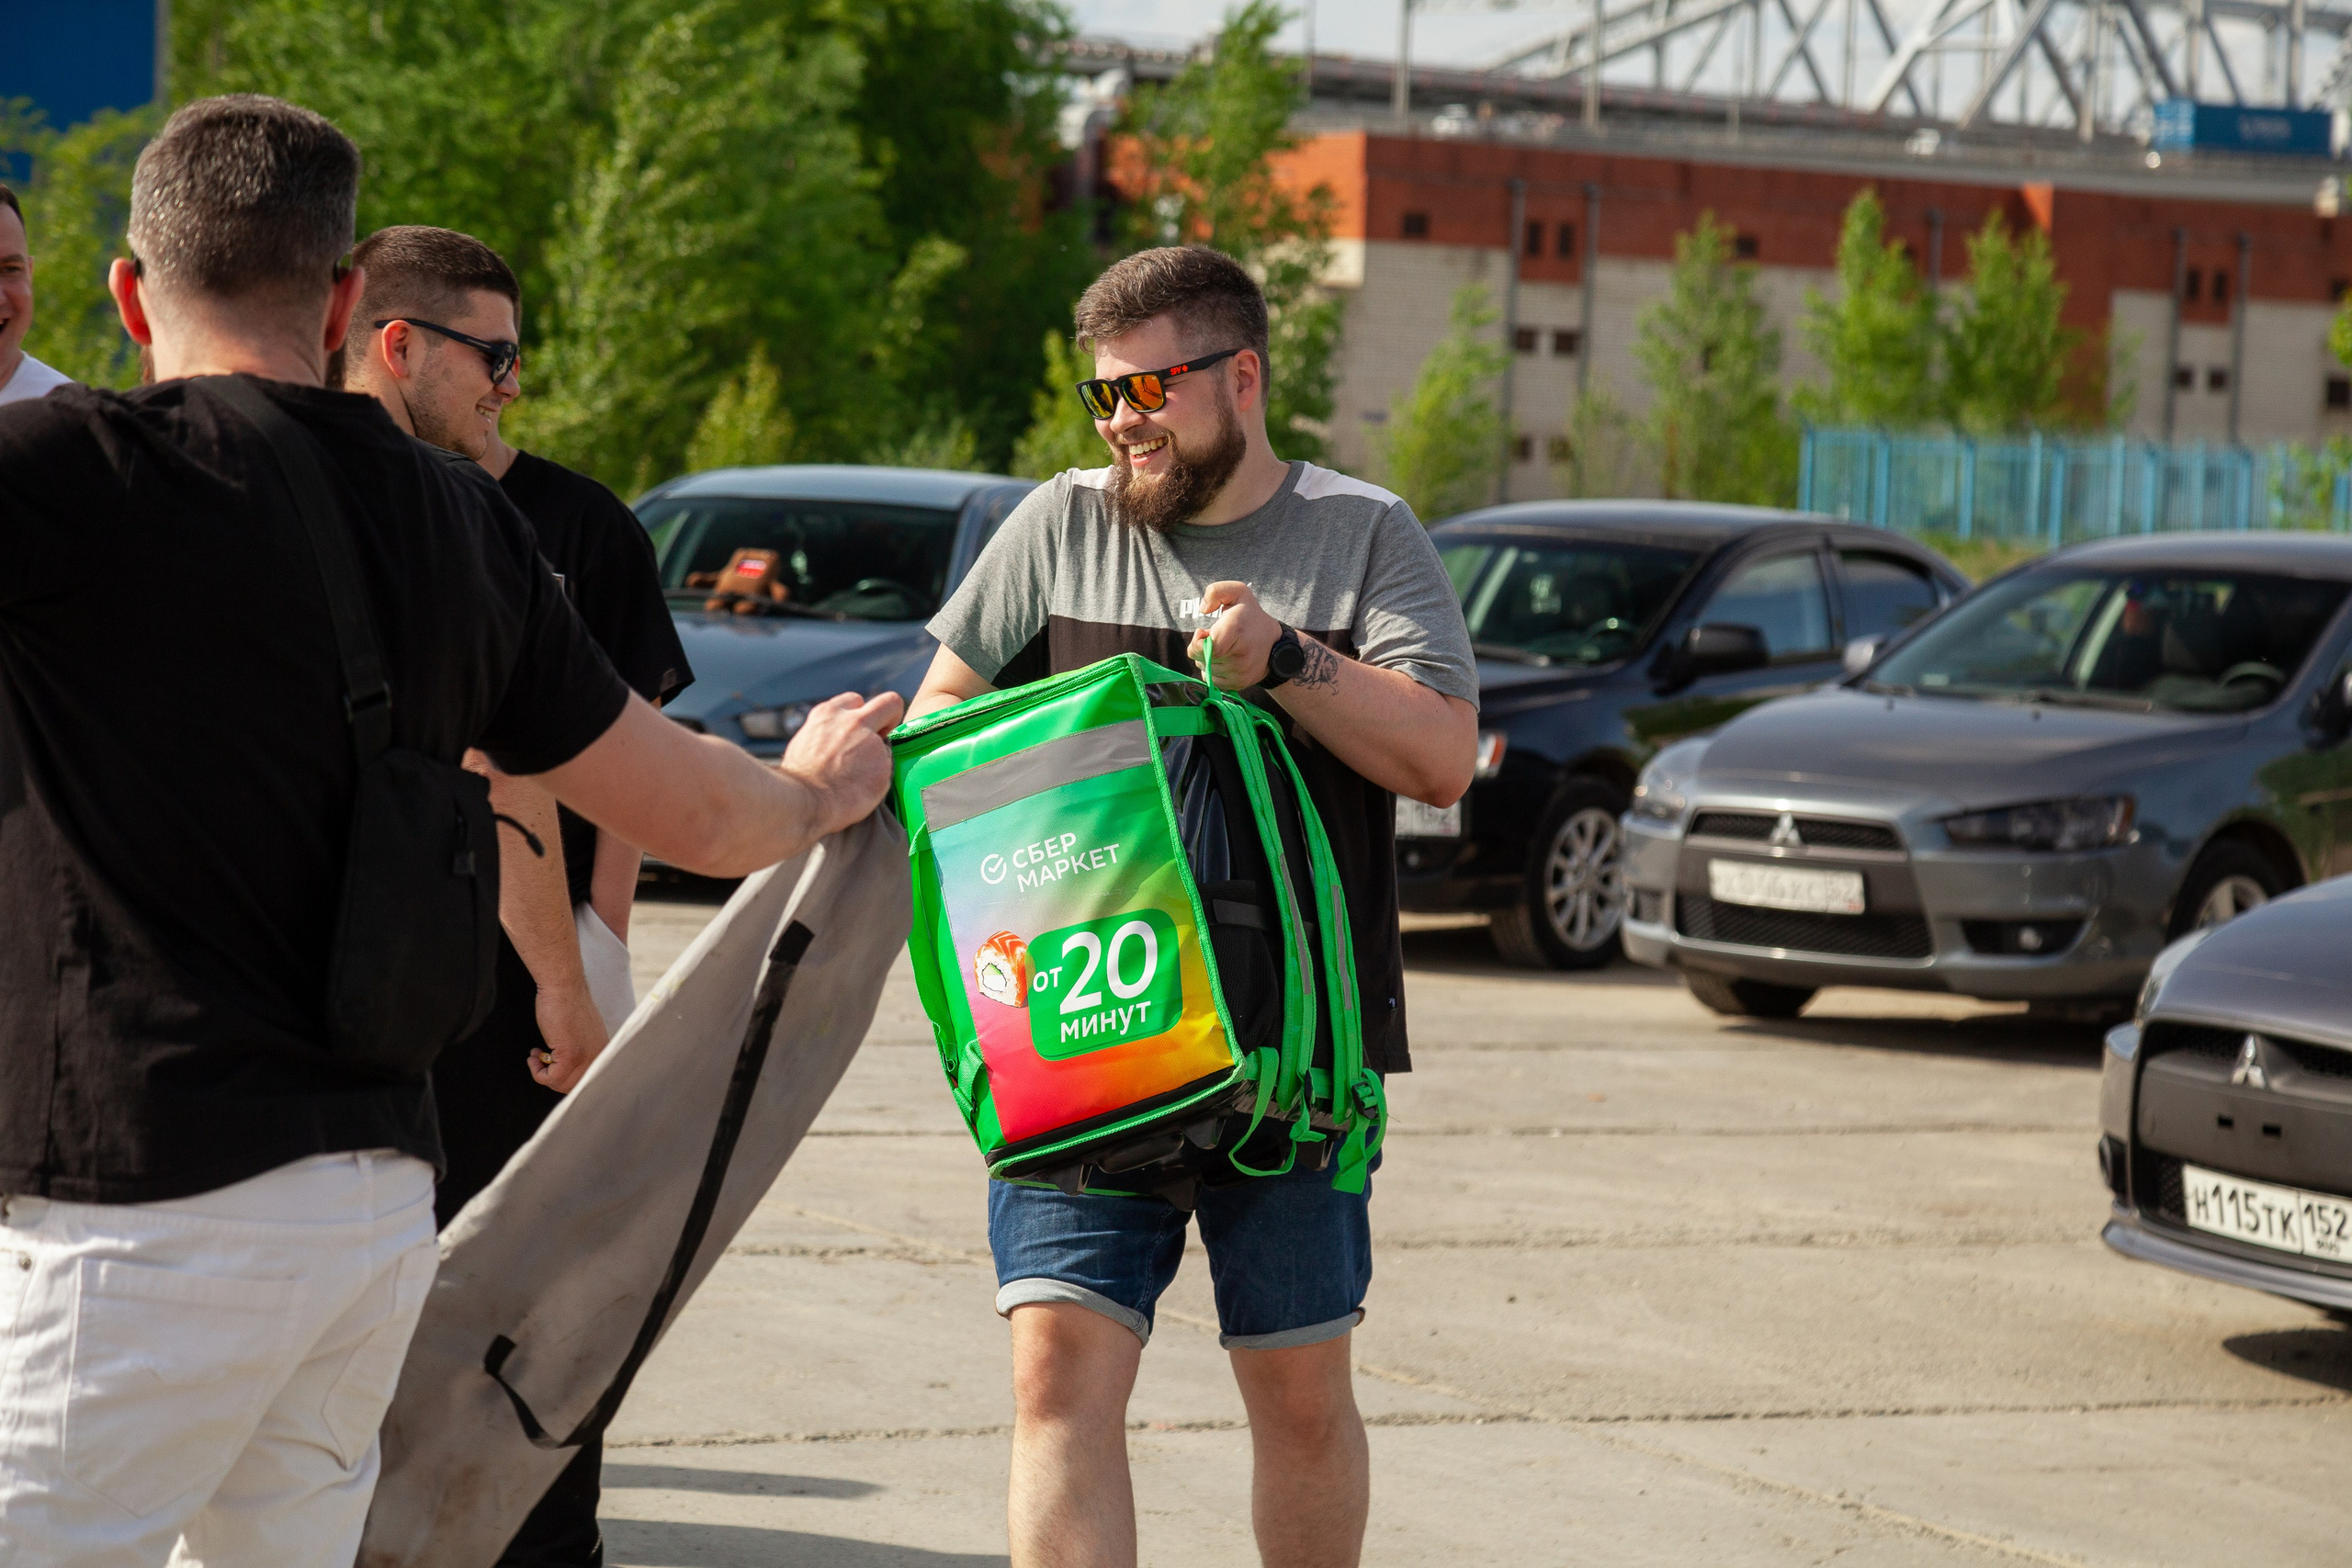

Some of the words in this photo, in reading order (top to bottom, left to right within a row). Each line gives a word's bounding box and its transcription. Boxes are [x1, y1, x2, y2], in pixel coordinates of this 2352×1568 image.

[1012, 832, 1077, 869] СБЕР
[1016, 843, 1120, 894] МАРКЕТ
[1059, 919, 1159, 1016] 20
[1060, 1000, 1151, 1043] минут
[2303, 1202, 2349, 1240] 152
